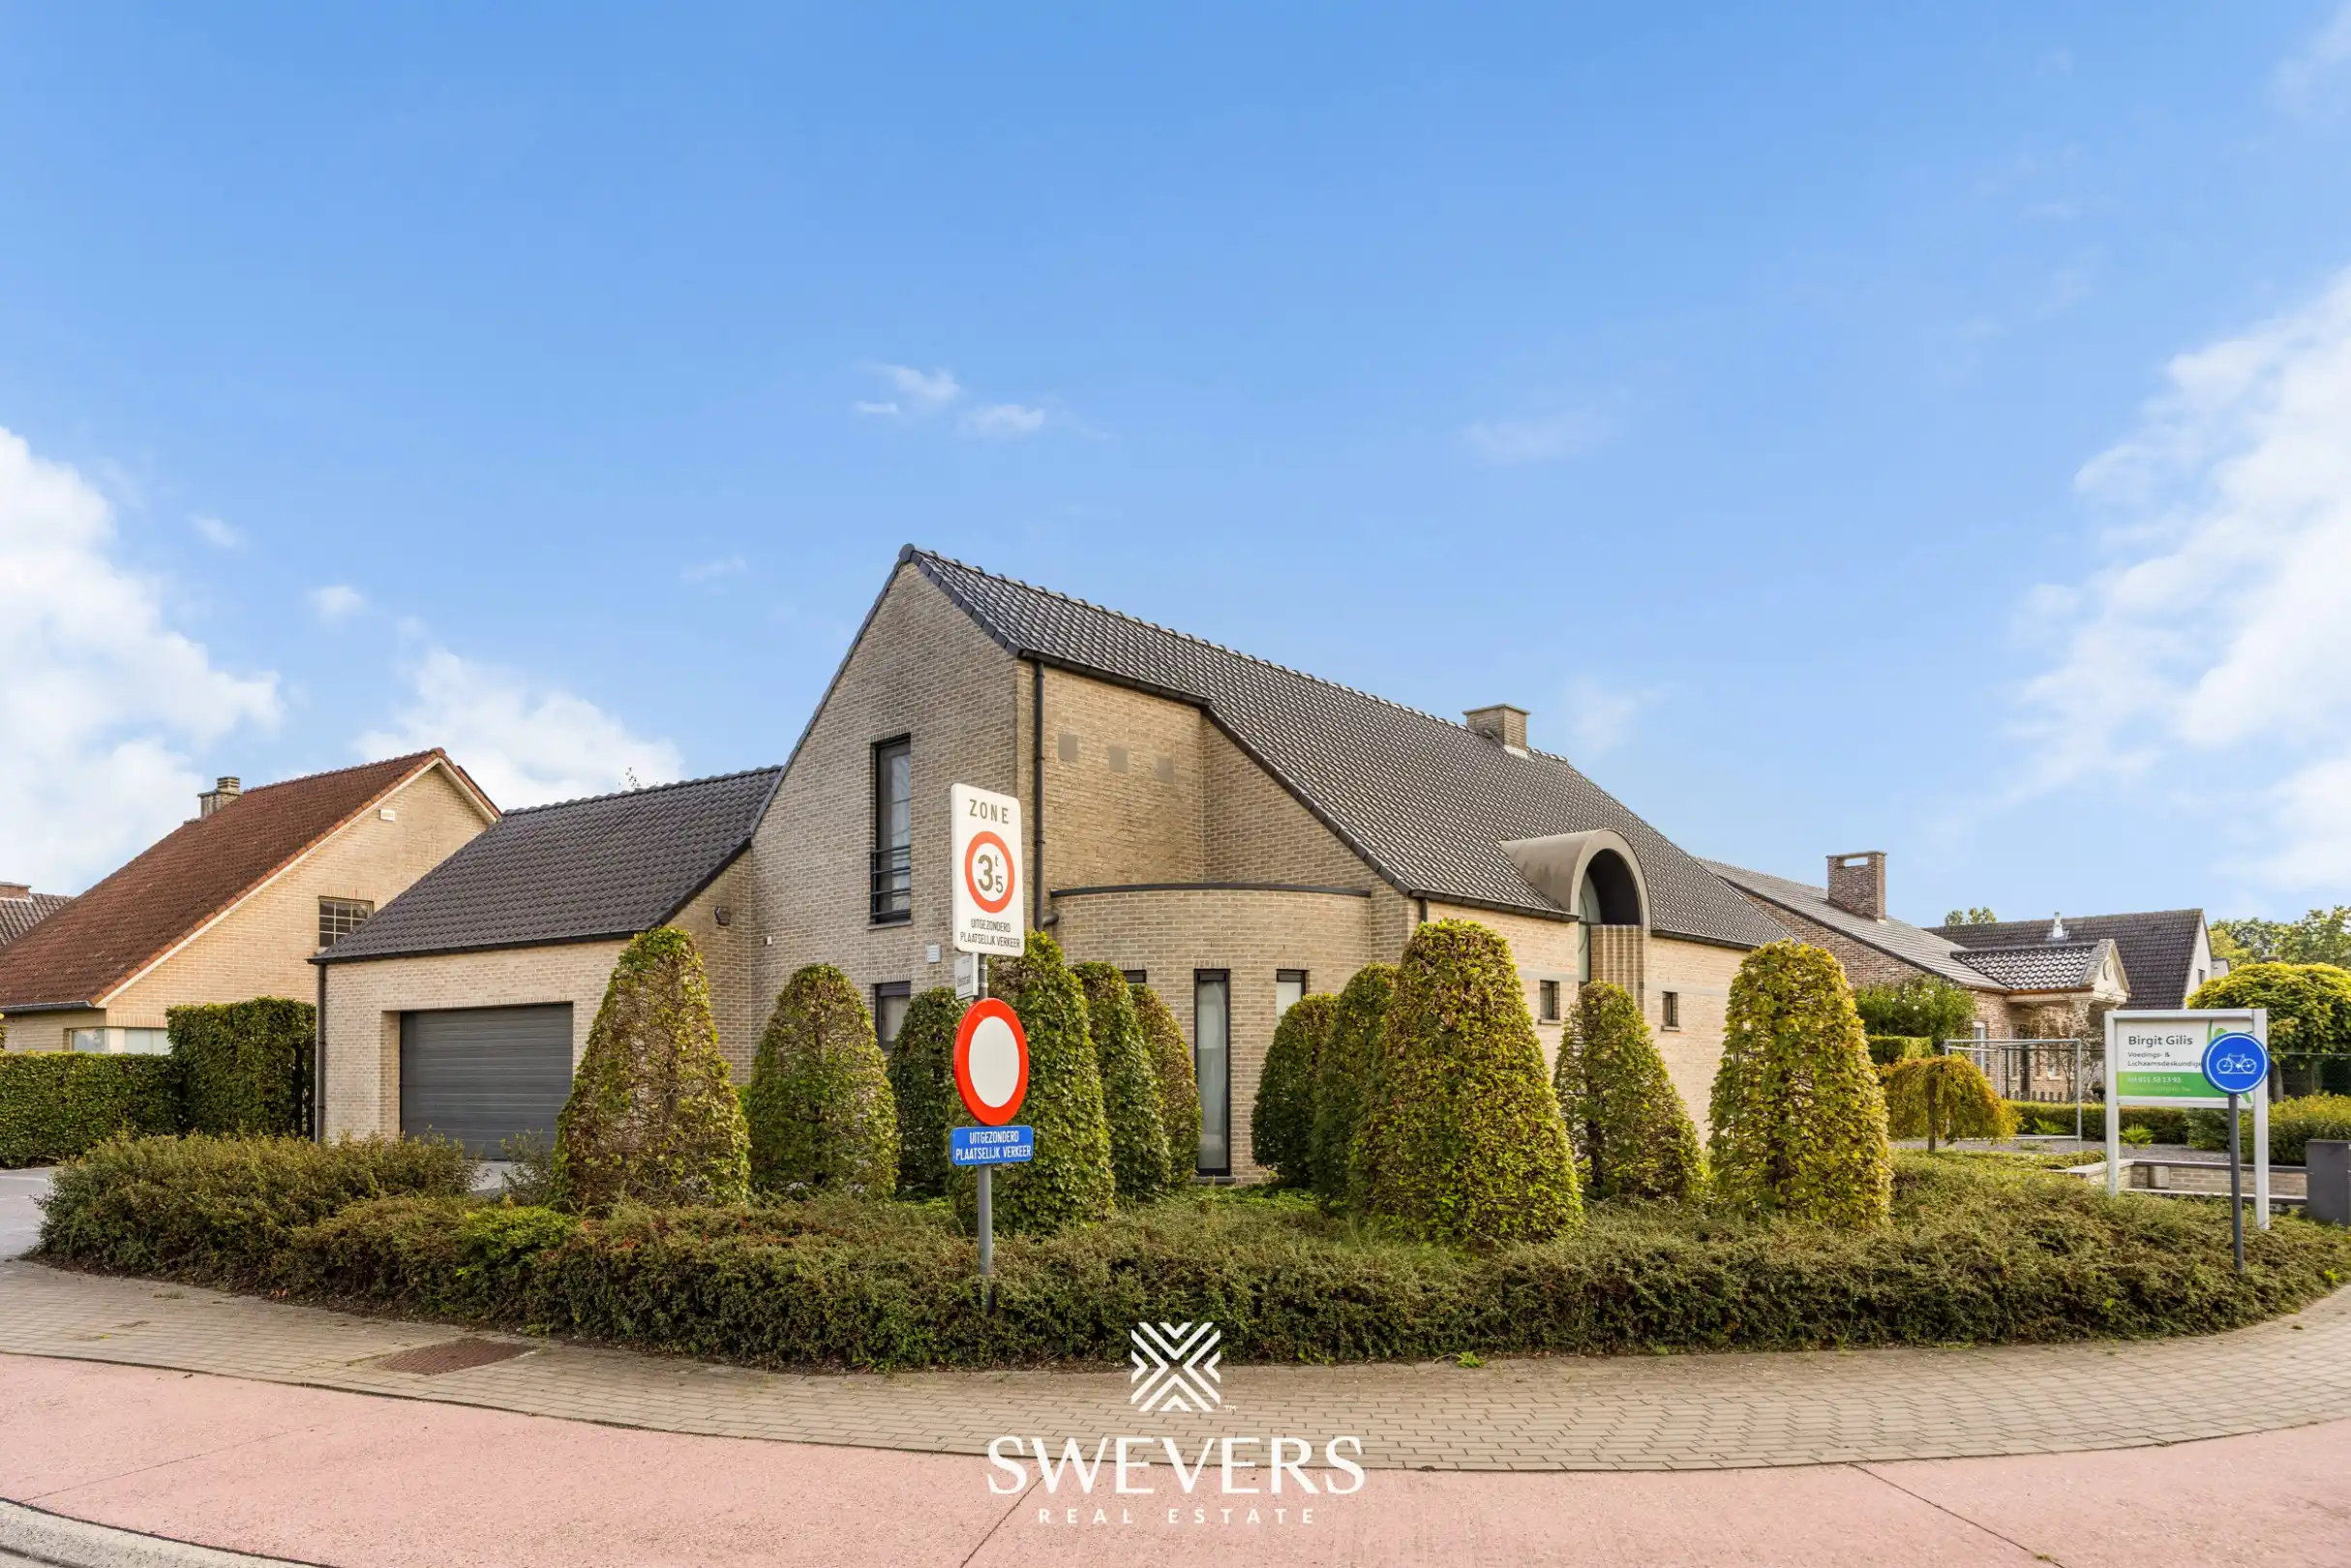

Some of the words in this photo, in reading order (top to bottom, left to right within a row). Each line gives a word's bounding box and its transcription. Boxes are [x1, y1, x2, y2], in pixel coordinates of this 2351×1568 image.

[970, 799, 1009, 825] ZONE
[971, 918, 1011, 933] UITGEZONDERD
[959, 931, 996, 946] PLAATSELIJK
[996, 935, 1021, 949] VERKEER
[2128, 1035, 2163, 1048] Birgit
[2165, 1035, 2193, 1045] Gilis
[969, 1131, 1020, 1145] UITGEZONDERD
[955, 1146, 1001, 1161] PLAATSELIJK
[1003, 1144, 1032, 1159] VERKEER
